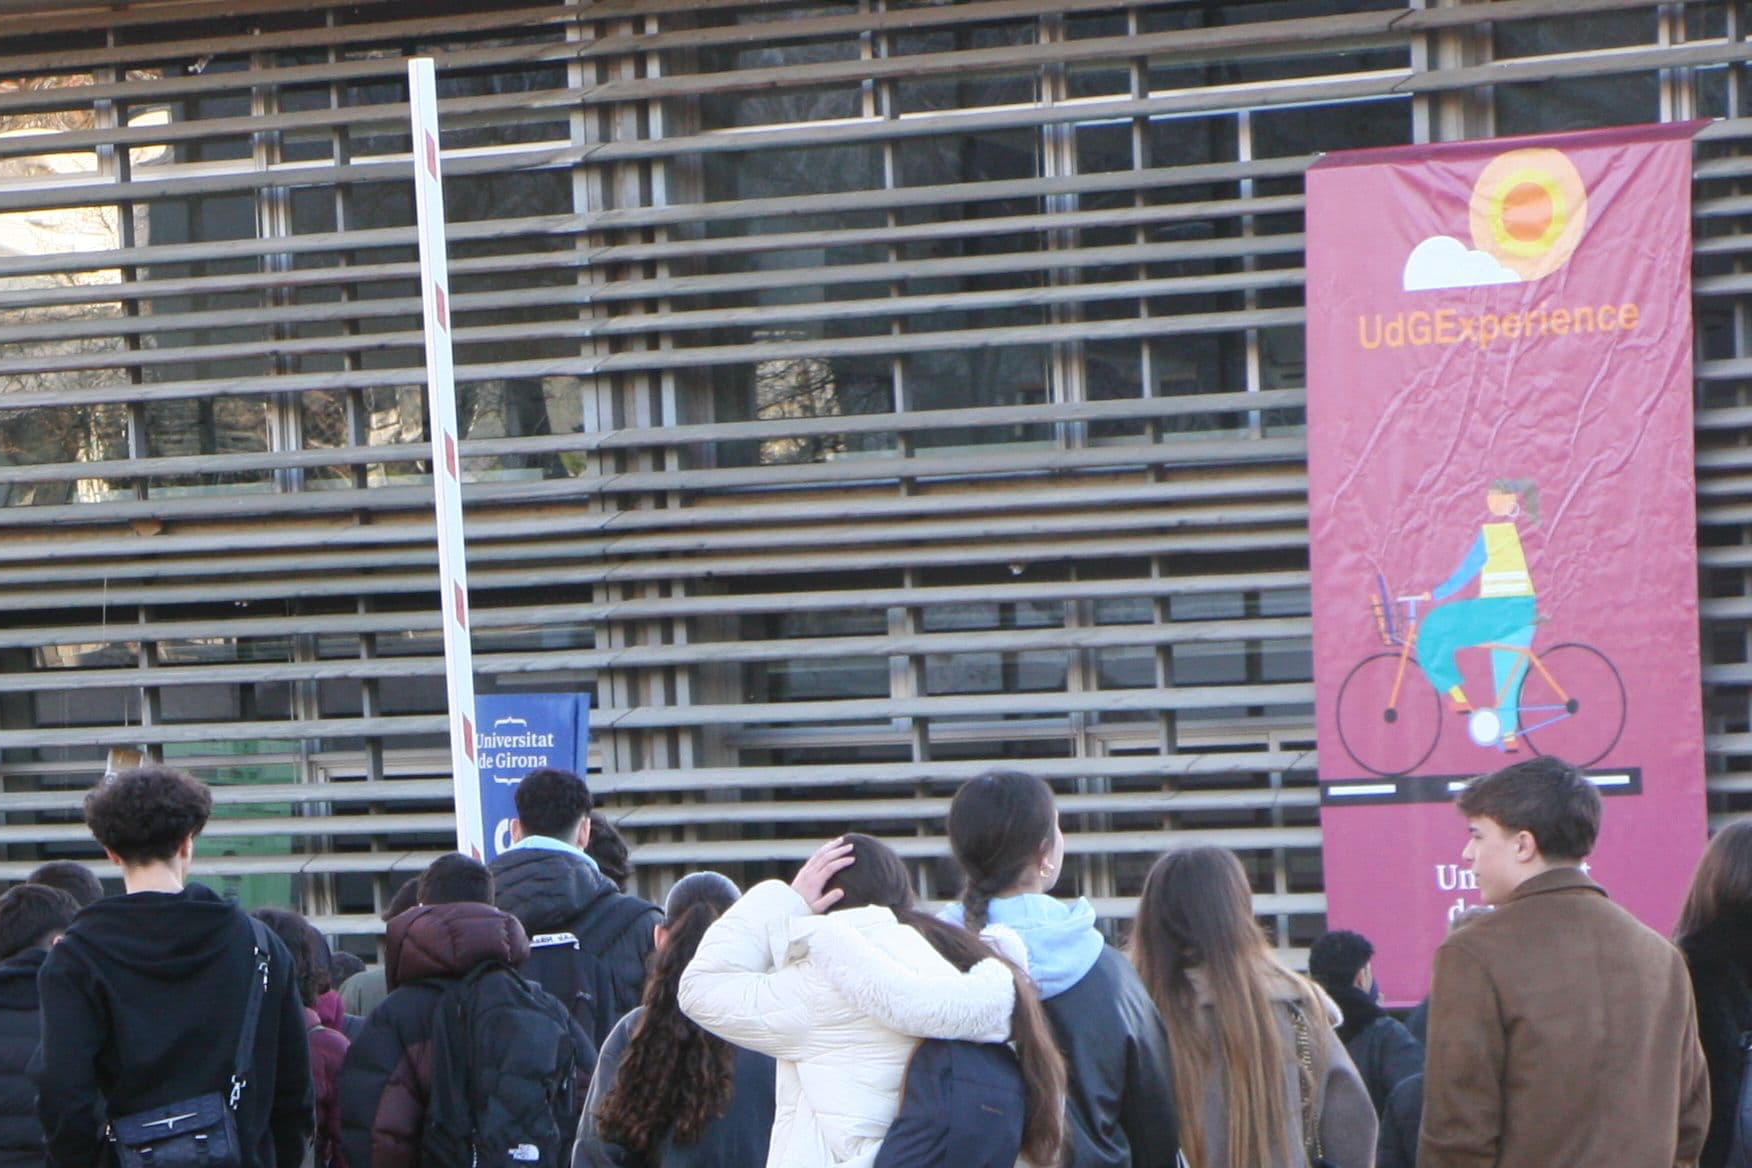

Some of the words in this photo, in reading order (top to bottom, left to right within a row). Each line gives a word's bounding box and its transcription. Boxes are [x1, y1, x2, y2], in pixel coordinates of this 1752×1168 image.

[1359, 302, 1640, 349] UdGExperience
[477, 731, 554, 749] Universitat
[479, 752, 494, 769] de
[496, 752, 547, 769] Girona
